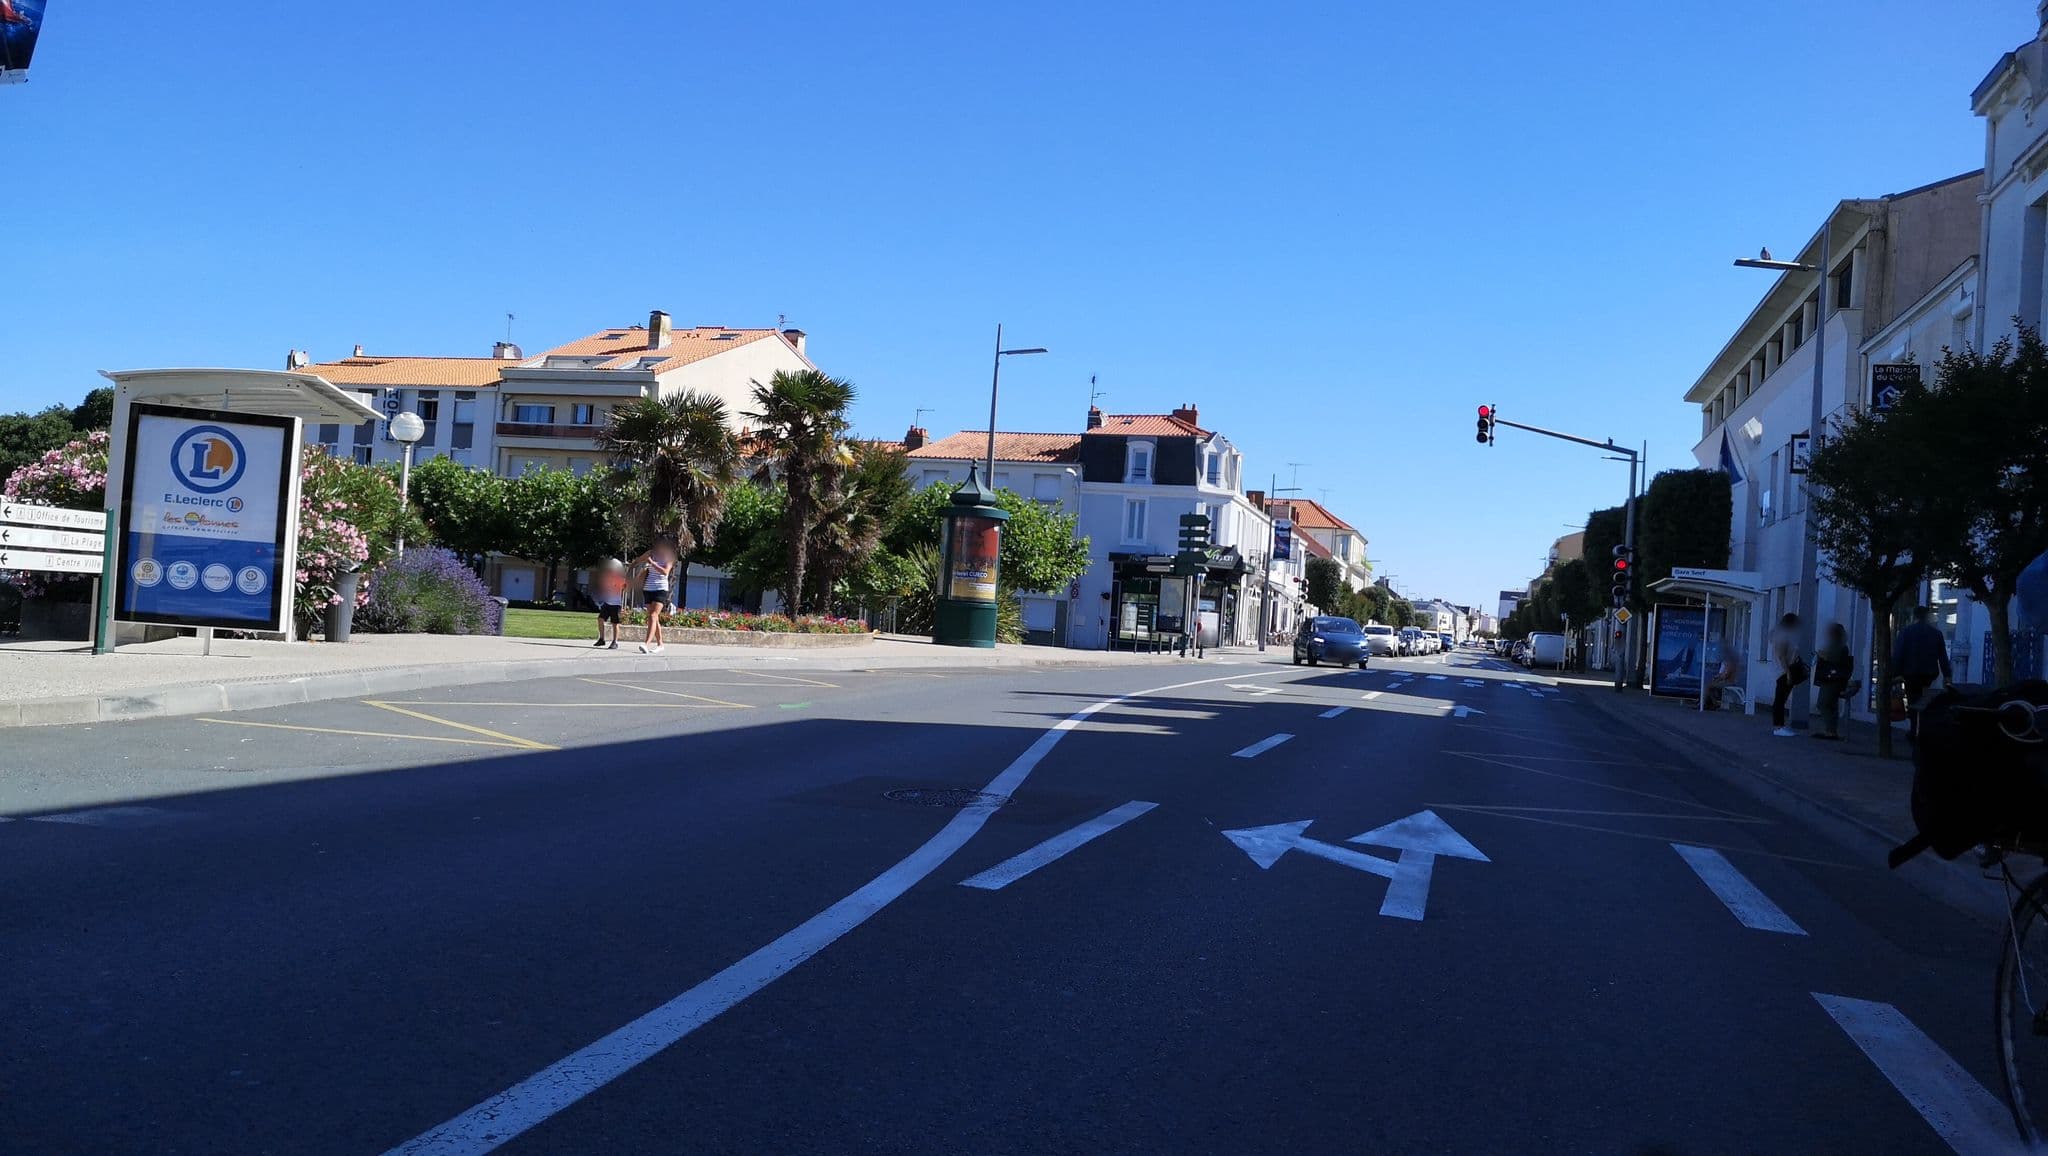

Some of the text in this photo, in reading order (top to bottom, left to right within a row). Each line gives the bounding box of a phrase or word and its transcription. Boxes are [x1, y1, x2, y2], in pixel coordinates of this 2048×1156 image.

[164, 493, 224, 508] E.Leclerc
[37, 510, 104, 526] Office de Tourisme
[71, 536, 102, 550] La Plage
[56, 557, 101, 569] Centre Ville
